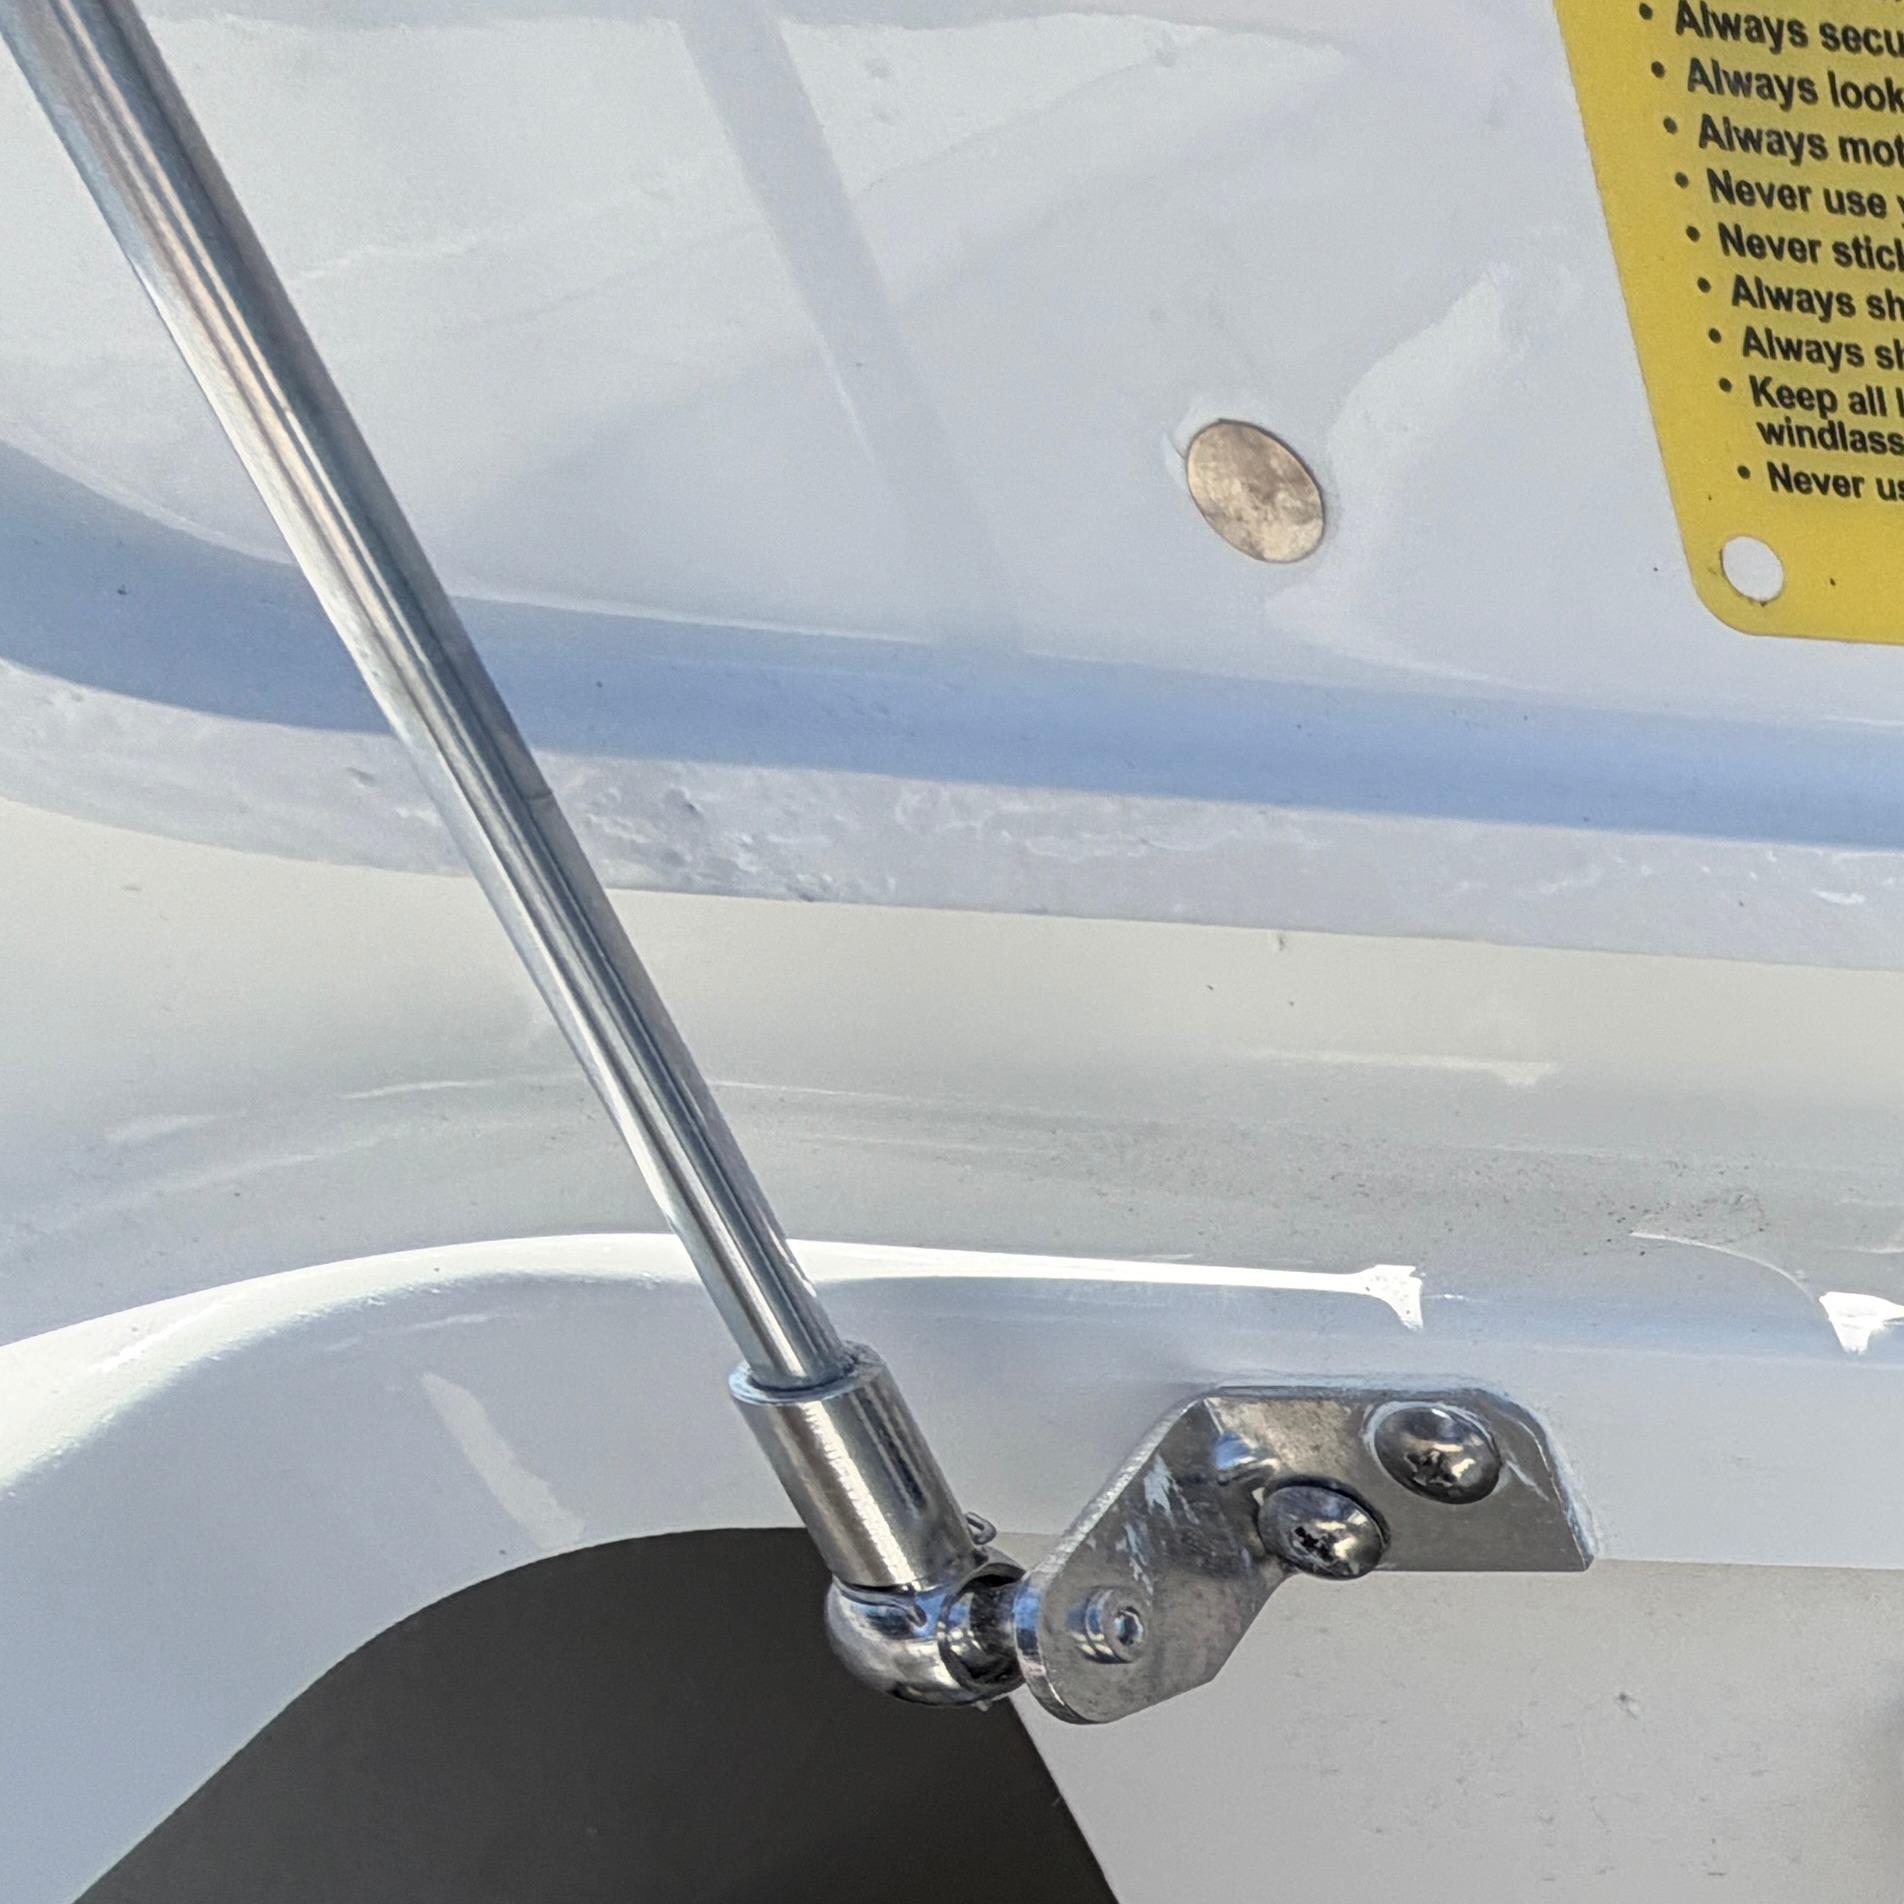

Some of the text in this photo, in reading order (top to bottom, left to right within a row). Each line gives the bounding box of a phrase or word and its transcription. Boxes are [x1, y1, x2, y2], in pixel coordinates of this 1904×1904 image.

[1676, 0, 1808, 54] Always
[1688, 57, 1818, 112] Always
[1699, 114, 1828, 166] Always
[1707, 168, 1812, 211] Never
[1824, 189, 1887, 219] use
[1718, 223, 1821, 263] Never
[1732, 275, 1856, 323] Always
[1743, 326, 1864, 373] Always
[1749, 375, 1838, 420] Keep
[1848, 385, 1887, 416] all
[1767, 461, 1864, 498] Never
